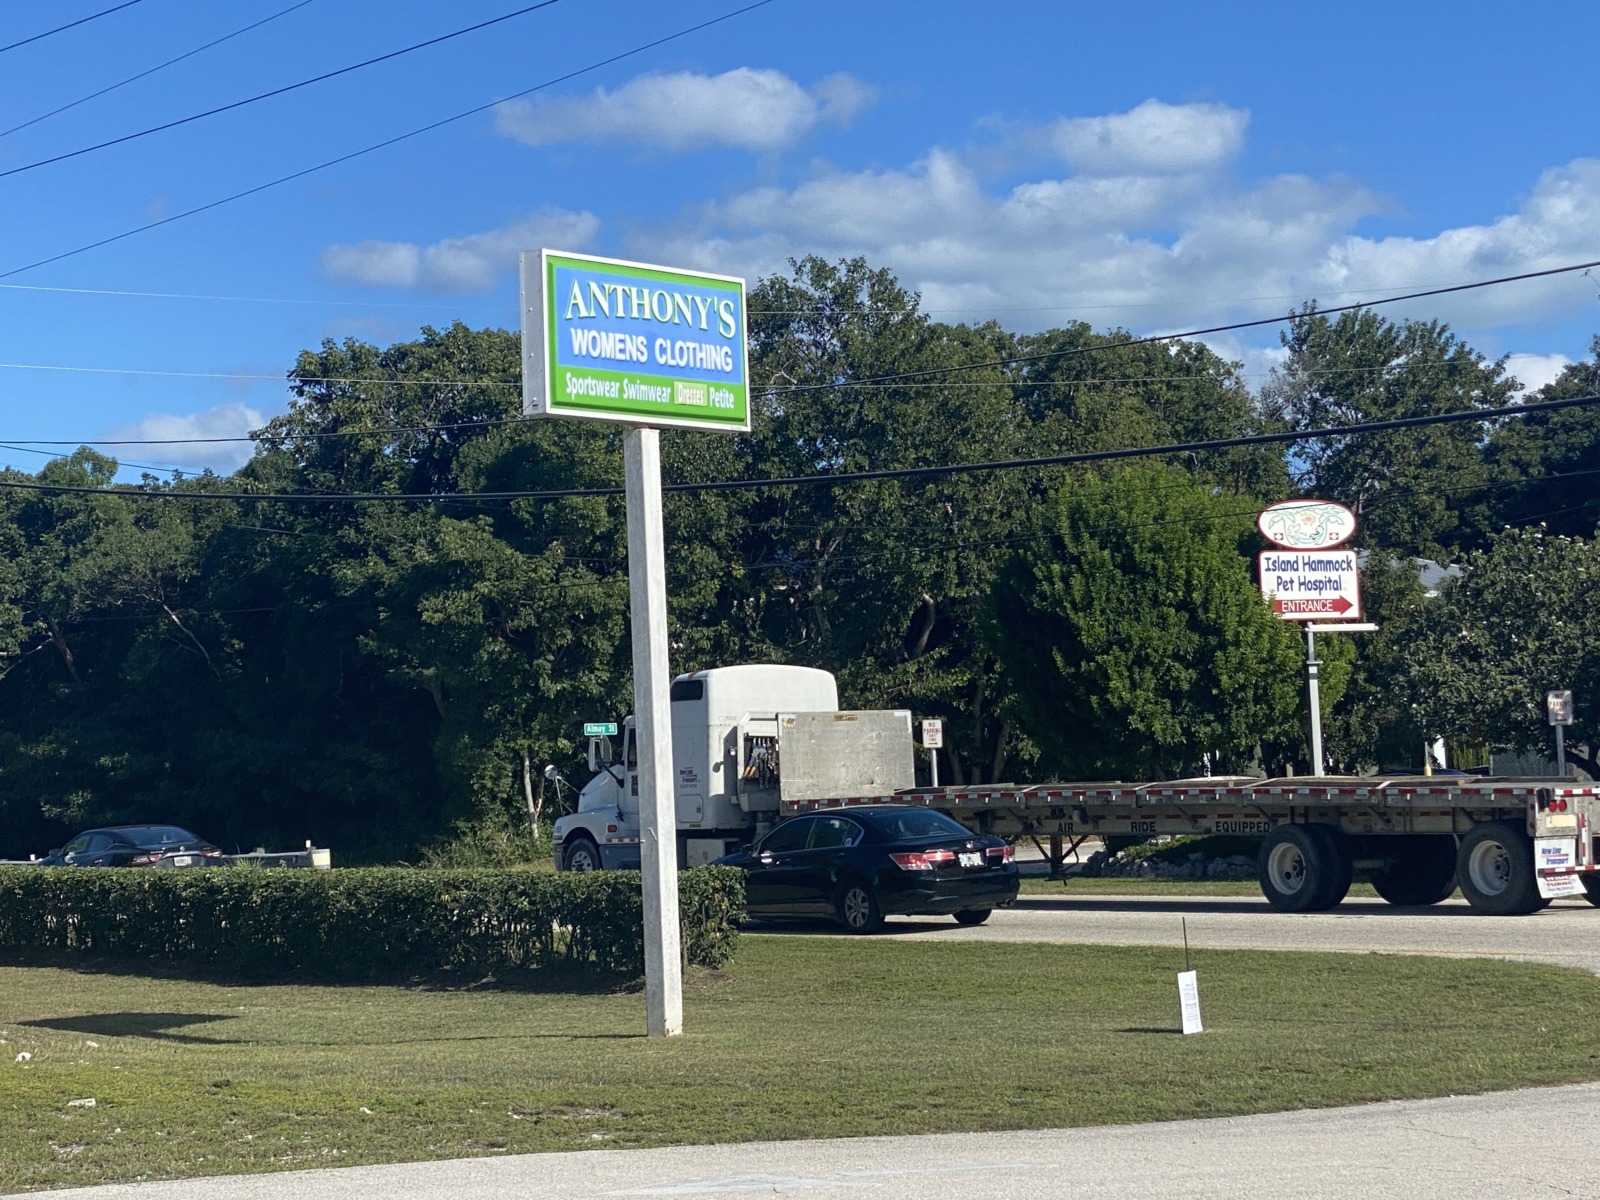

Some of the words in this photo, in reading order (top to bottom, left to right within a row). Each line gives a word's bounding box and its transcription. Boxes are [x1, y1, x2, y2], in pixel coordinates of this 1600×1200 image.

[565, 279, 736, 339] ANTHONY'S
[570, 327, 648, 364] WOMENS
[655, 338, 733, 373] CLOTHING
[566, 372, 619, 400] Sportswear
[623, 378, 671, 404] Swimwear
[677, 383, 704, 405] Dresses
[709, 387, 734, 409] Petite
[1264, 555, 1299, 572] Island
[1302, 555, 1353, 573] Hammock
[1276, 575, 1294, 592] Pet
[1298, 575, 1342, 596] Hospital
[1281, 599, 1333, 612] ENTRANCE
[586, 724, 606, 734] Almay
[608, 724, 615, 732] St
[1057, 822, 1074, 833] AIR
[1130, 821, 1156, 832] RIDE
[1215, 821, 1270, 833] EQUIPPED
[1546, 857, 1569, 866] Transport
